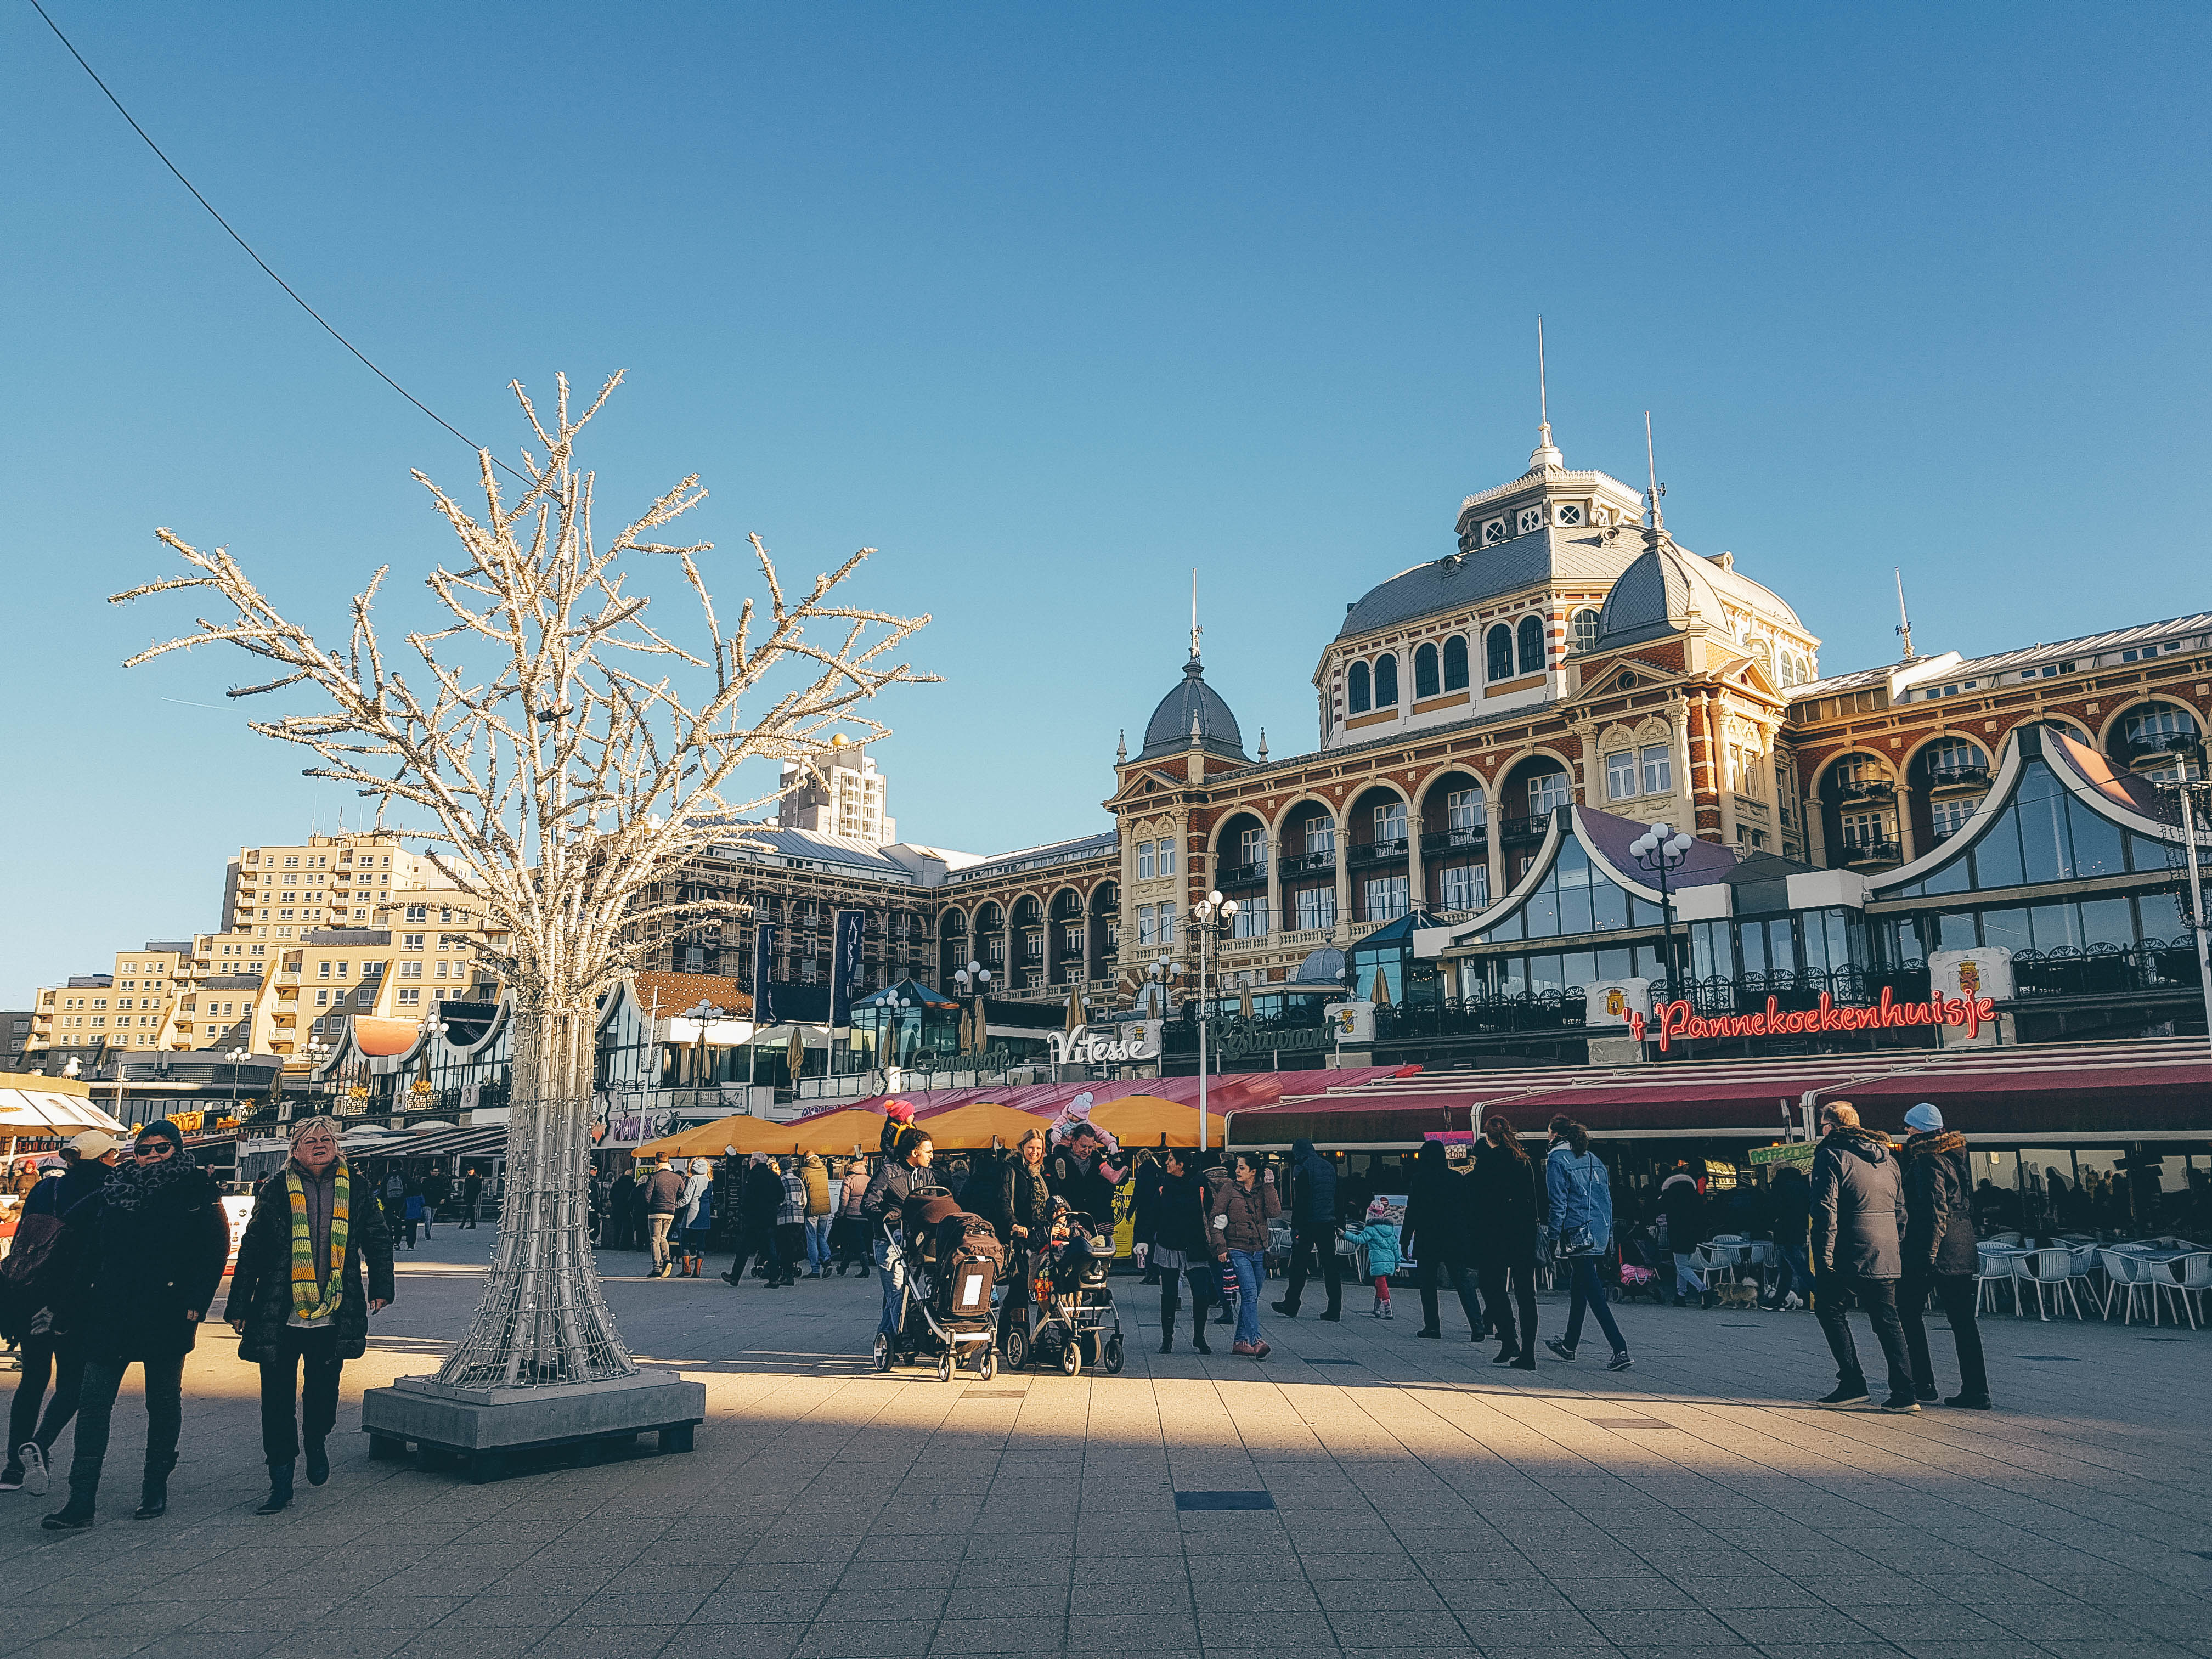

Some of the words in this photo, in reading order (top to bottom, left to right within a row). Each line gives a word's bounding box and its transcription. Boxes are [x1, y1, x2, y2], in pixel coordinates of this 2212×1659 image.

[1047, 1024, 1160, 1064] Vitesse
[1204, 1015, 1345, 1061] Restaurant
[1622, 1007, 1646, 1041] 't
[1655, 985, 1995, 1052] Pannekoekenhuisje
